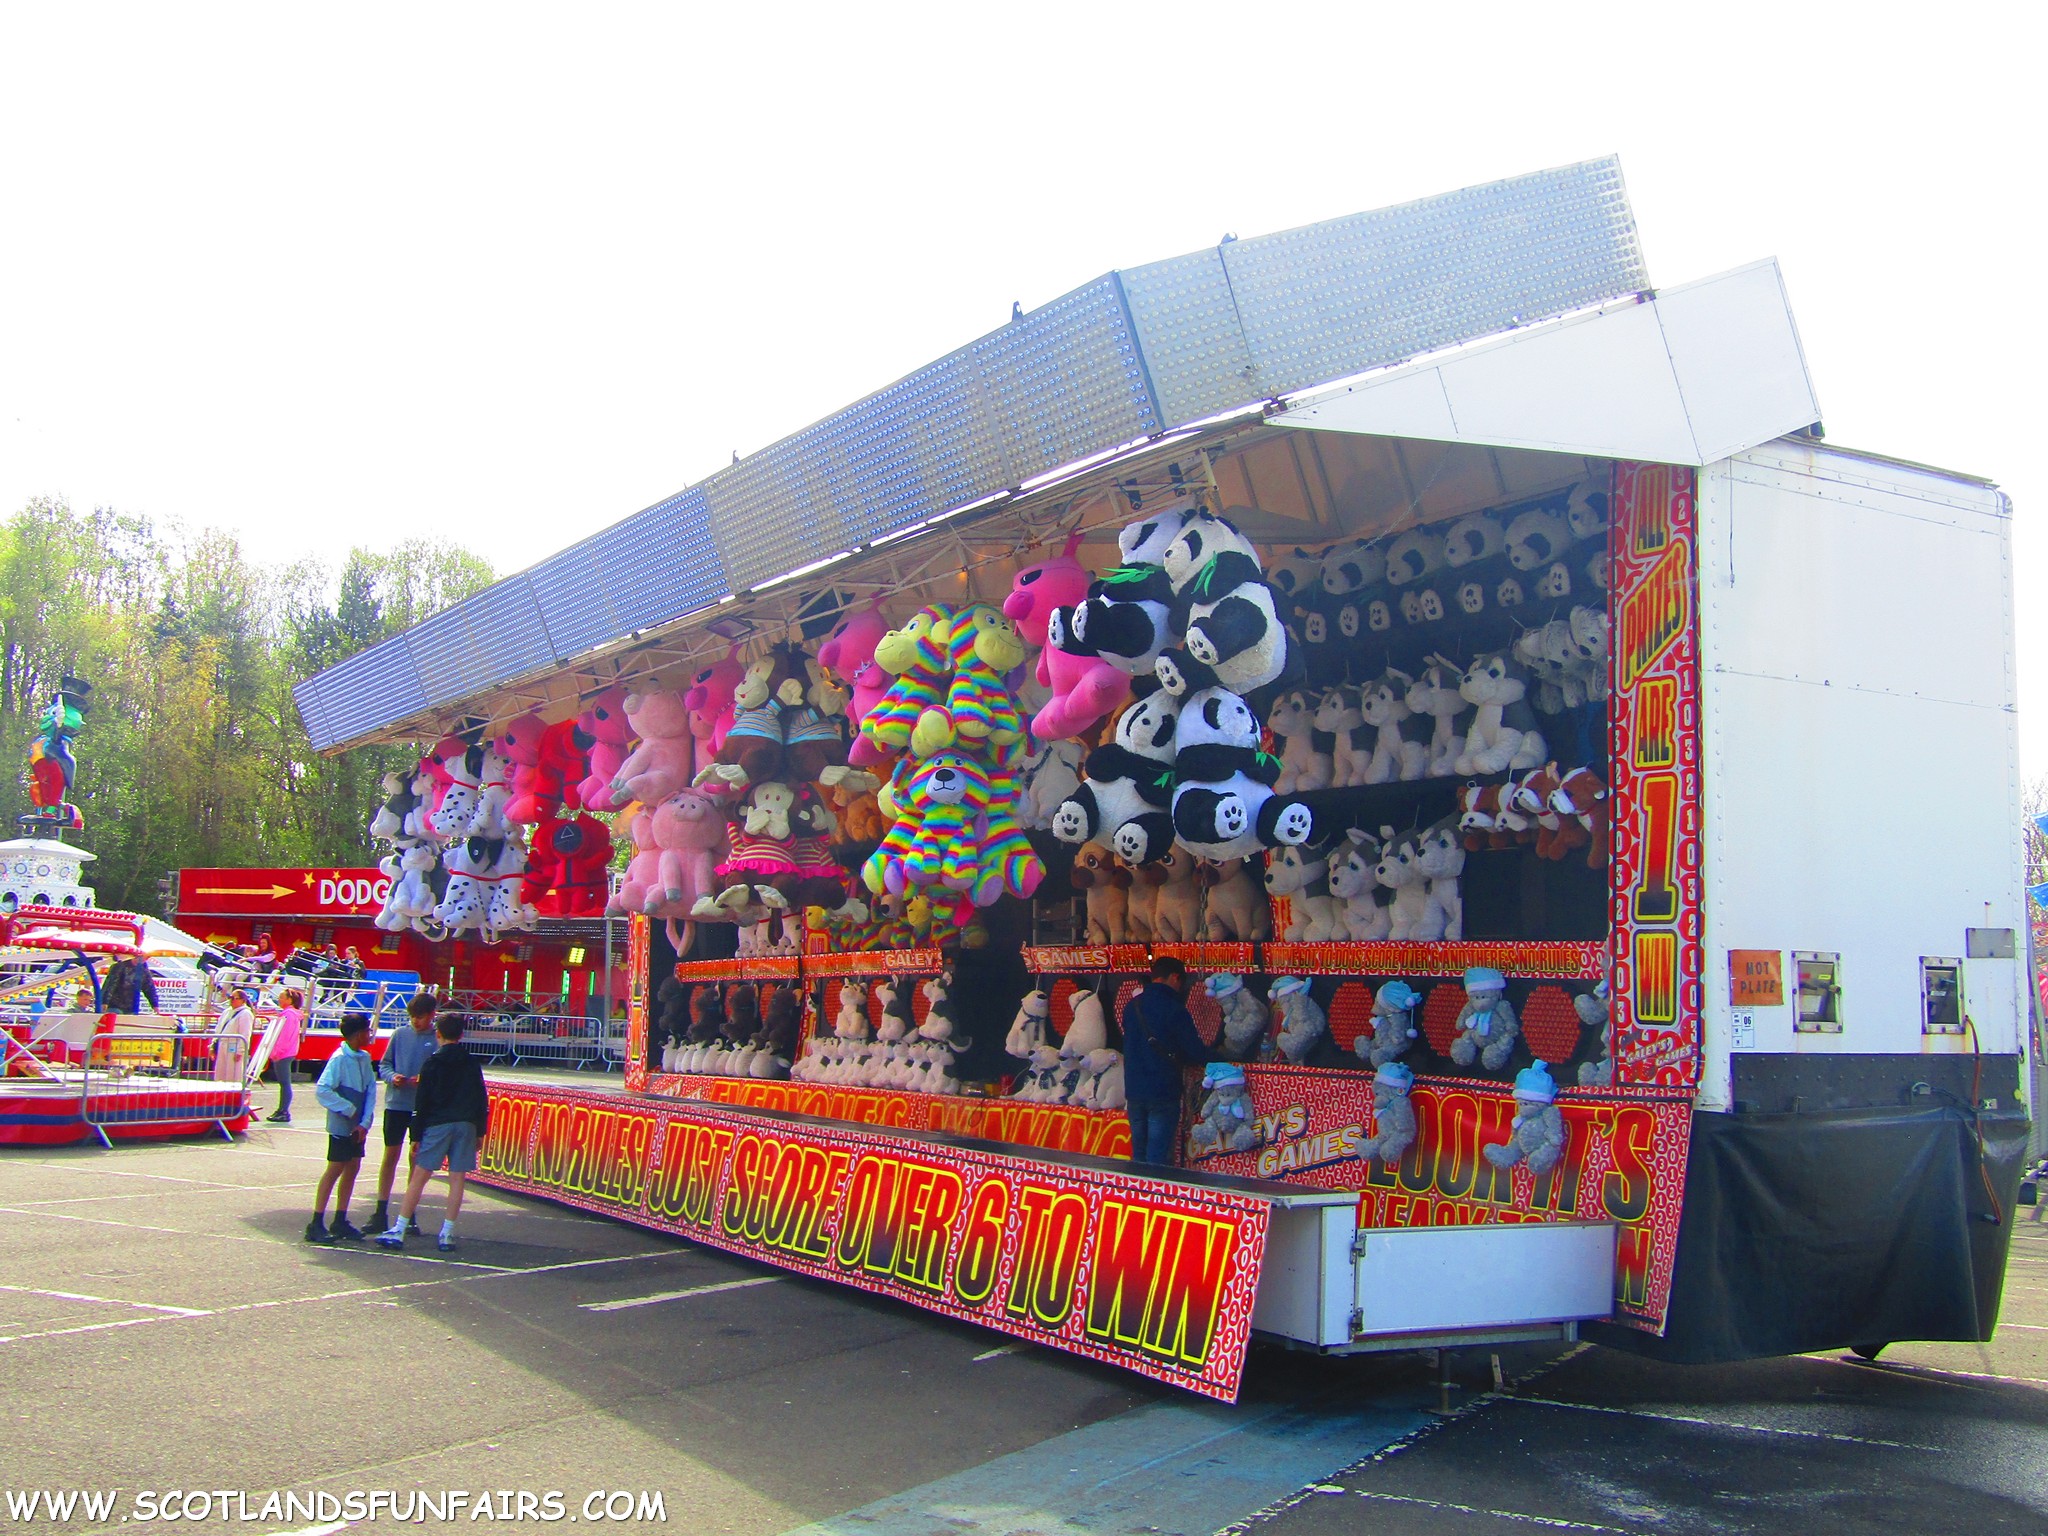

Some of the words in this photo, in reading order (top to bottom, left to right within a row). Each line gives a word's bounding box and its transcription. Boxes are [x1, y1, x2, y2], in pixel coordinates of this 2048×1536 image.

[1636, 465, 1668, 552] ALL
[1623, 541, 1685, 689] PRIZES
[1635, 679, 1675, 768] ARE
[1635, 776, 1676, 921] 1
[1036, 950, 1109, 966] GAMES
[1319, 948, 1334, 968] TO
[1335, 948, 1350, 969] DO
[1351, 948, 1363, 969] IS
[1365, 948, 1399, 970] SCORE
[1430, 949, 1439, 971] 6
[1441, 949, 1467, 971] AND
[1518, 949, 1539, 972] NO
[1540, 949, 1581, 973] RULES
[1635, 934, 1675, 1021] WIN
[1740, 980, 1775, 994] PLATE
[1743, 1016, 1752, 1025] 06
[1626, 1039, 1668, 1064] GALEY'S
[1656, 1044, 1692, 1067] GAMES
[1187, 1104, 1306, 1160] GAEY'S
[1257, 1124, 1365, 1179] GAMES
[480, 1096, 538, 1179] LOOK
[532, 1103, 571, 1186] NO
[563, 1107, 658, 1206] RULES!
[650, 1122, 735, 1226] JUST
[723, 1135, 851, 1258] SCORE
[837, 1156, 963, 1291] OVER
[955, 1180, 1009, 1301] 6
[1007, 1186, 1087, 1322] TO
[1087, 1201, 1235, 1365] WIN
